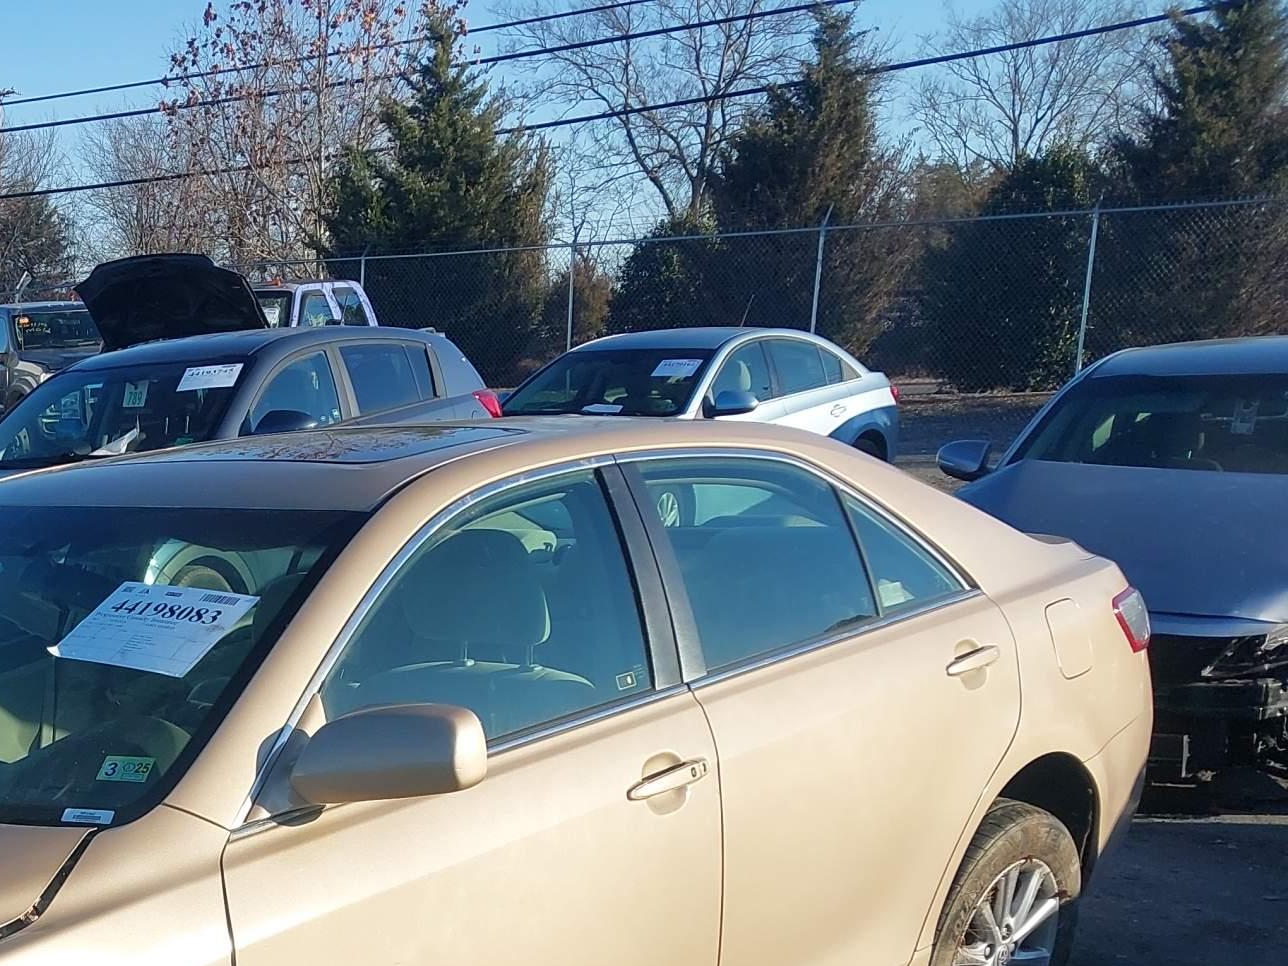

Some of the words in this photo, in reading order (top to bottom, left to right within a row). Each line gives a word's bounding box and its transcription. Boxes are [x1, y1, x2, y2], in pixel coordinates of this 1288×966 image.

[112, 600, 221, 624] 44198083
[104, 762, 118, 776] 3
[134, 763, 151, 774] 25
